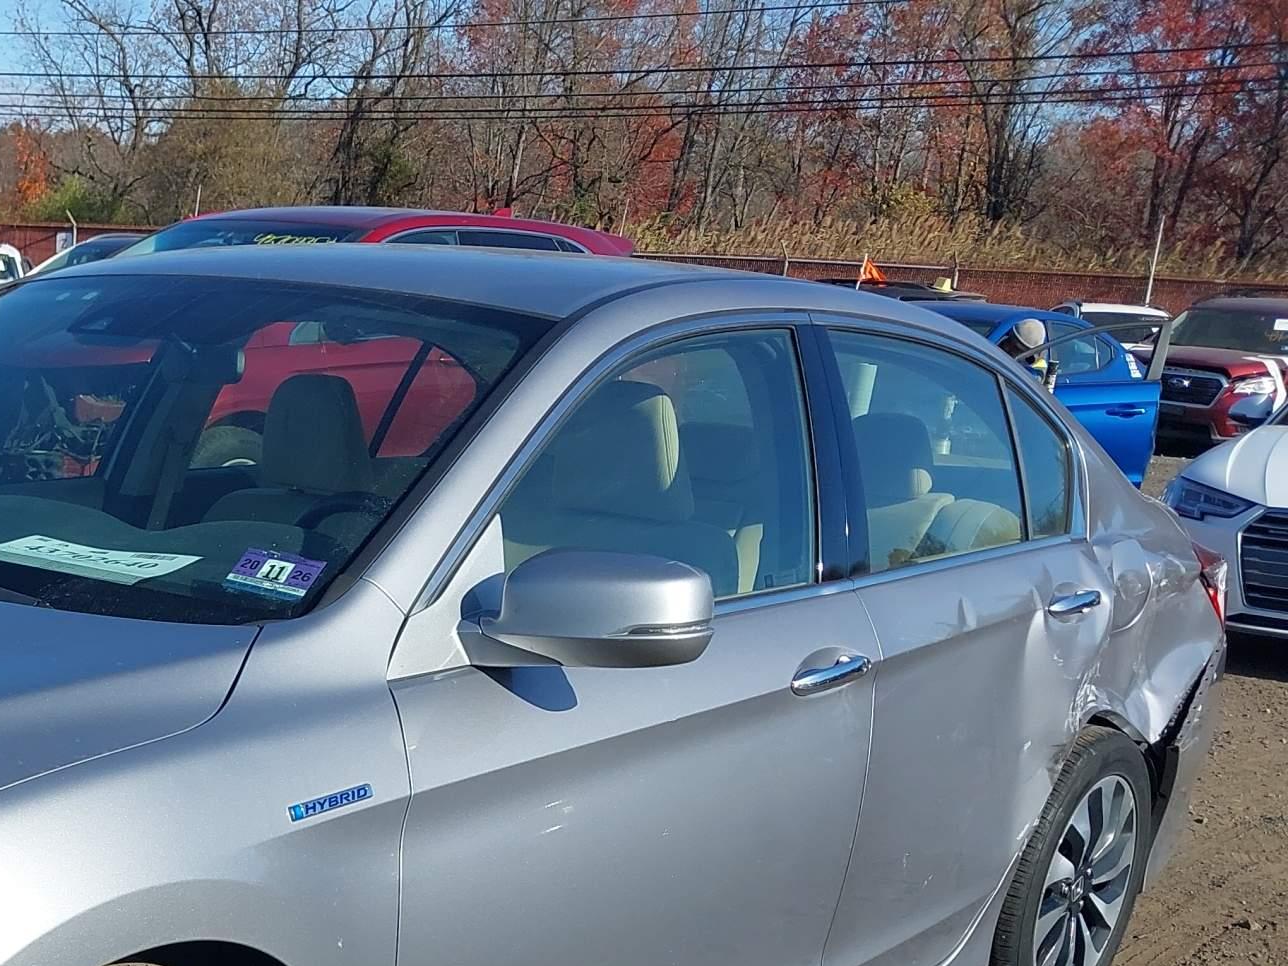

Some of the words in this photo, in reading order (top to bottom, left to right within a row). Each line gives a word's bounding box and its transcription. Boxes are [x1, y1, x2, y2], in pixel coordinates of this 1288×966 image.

[24, 543, 159, 570] 43702640
[240, 558, 261, 570] 20
[262, 564, 286, 581] 11
[290, 570, 313, 582] 26
[305, 787, 368, 815] HYBRID
